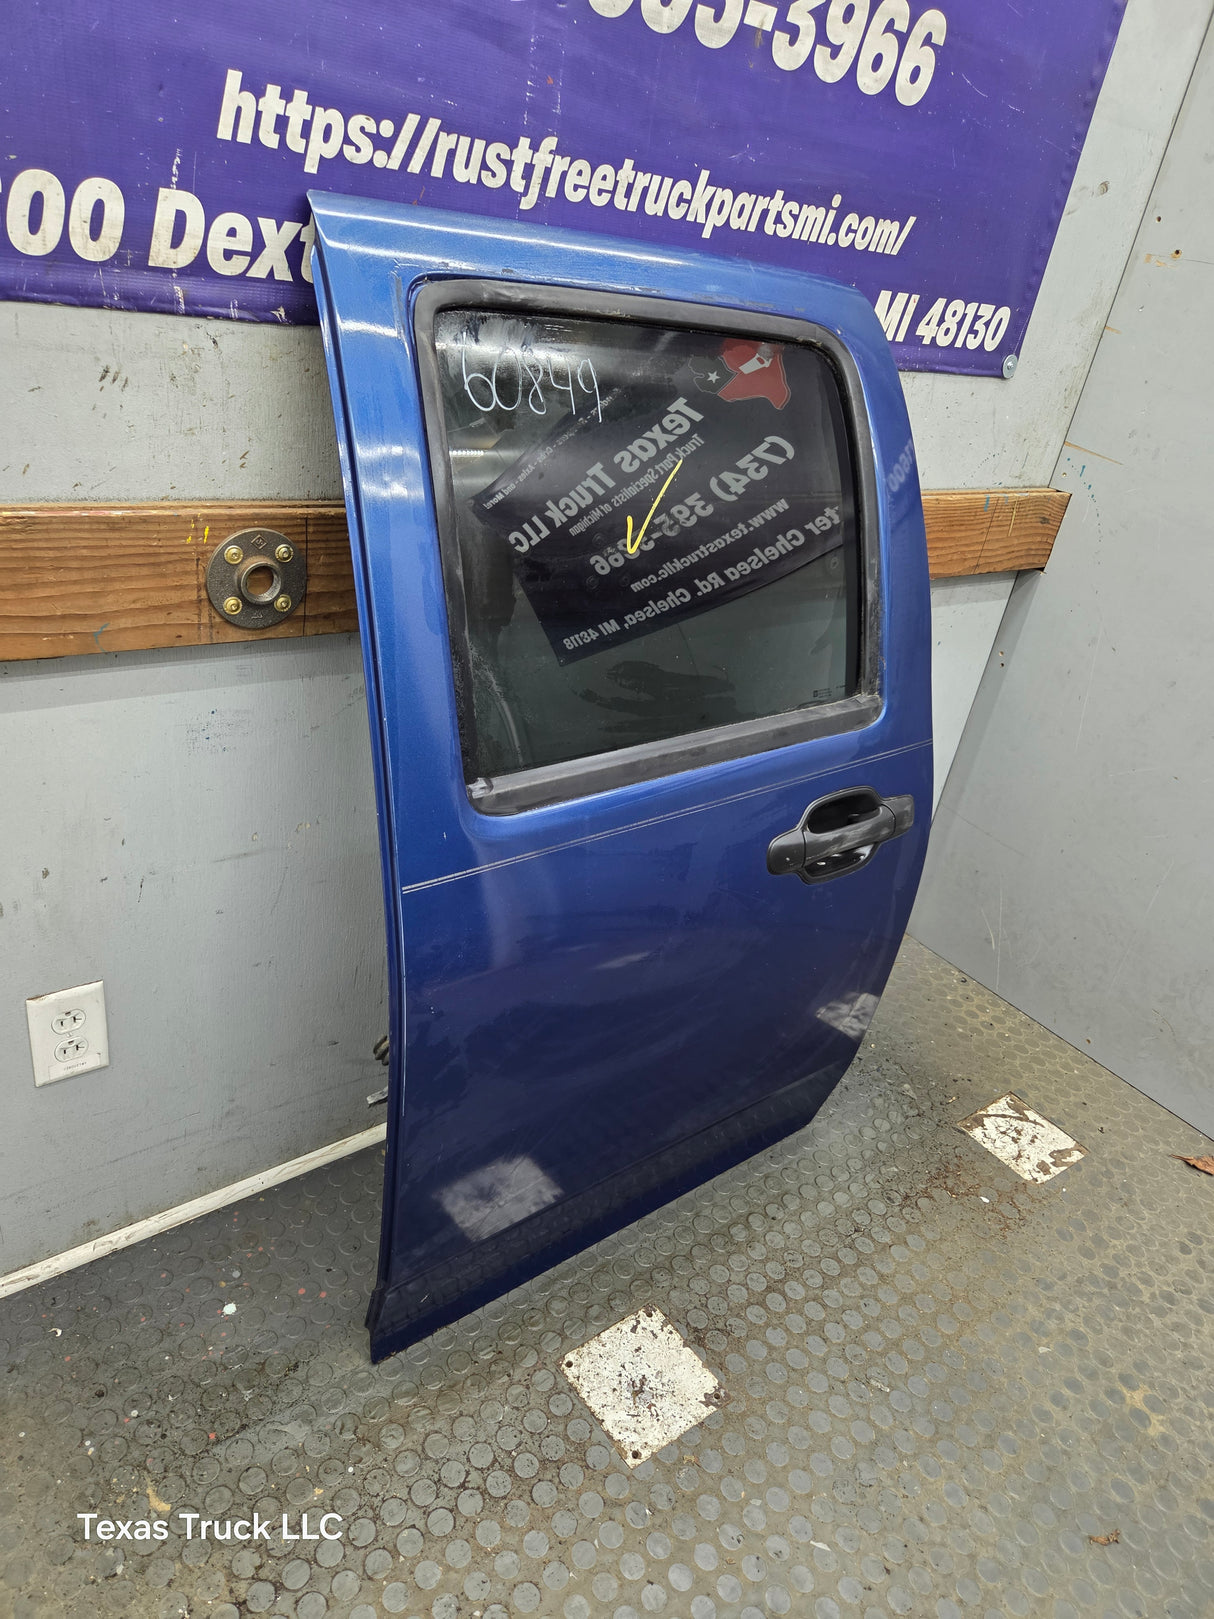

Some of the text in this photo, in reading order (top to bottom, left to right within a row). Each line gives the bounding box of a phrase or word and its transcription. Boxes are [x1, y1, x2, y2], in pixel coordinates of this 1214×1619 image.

[588, 0, 947, 107] -3966
[216, 69, 916, 256] https://rustfreetruckpartsmi.com/
[874, 290, 920, 342] MI
[915, 297, 1011, 352] 48130
[462, 331, 603, 423] 60849
